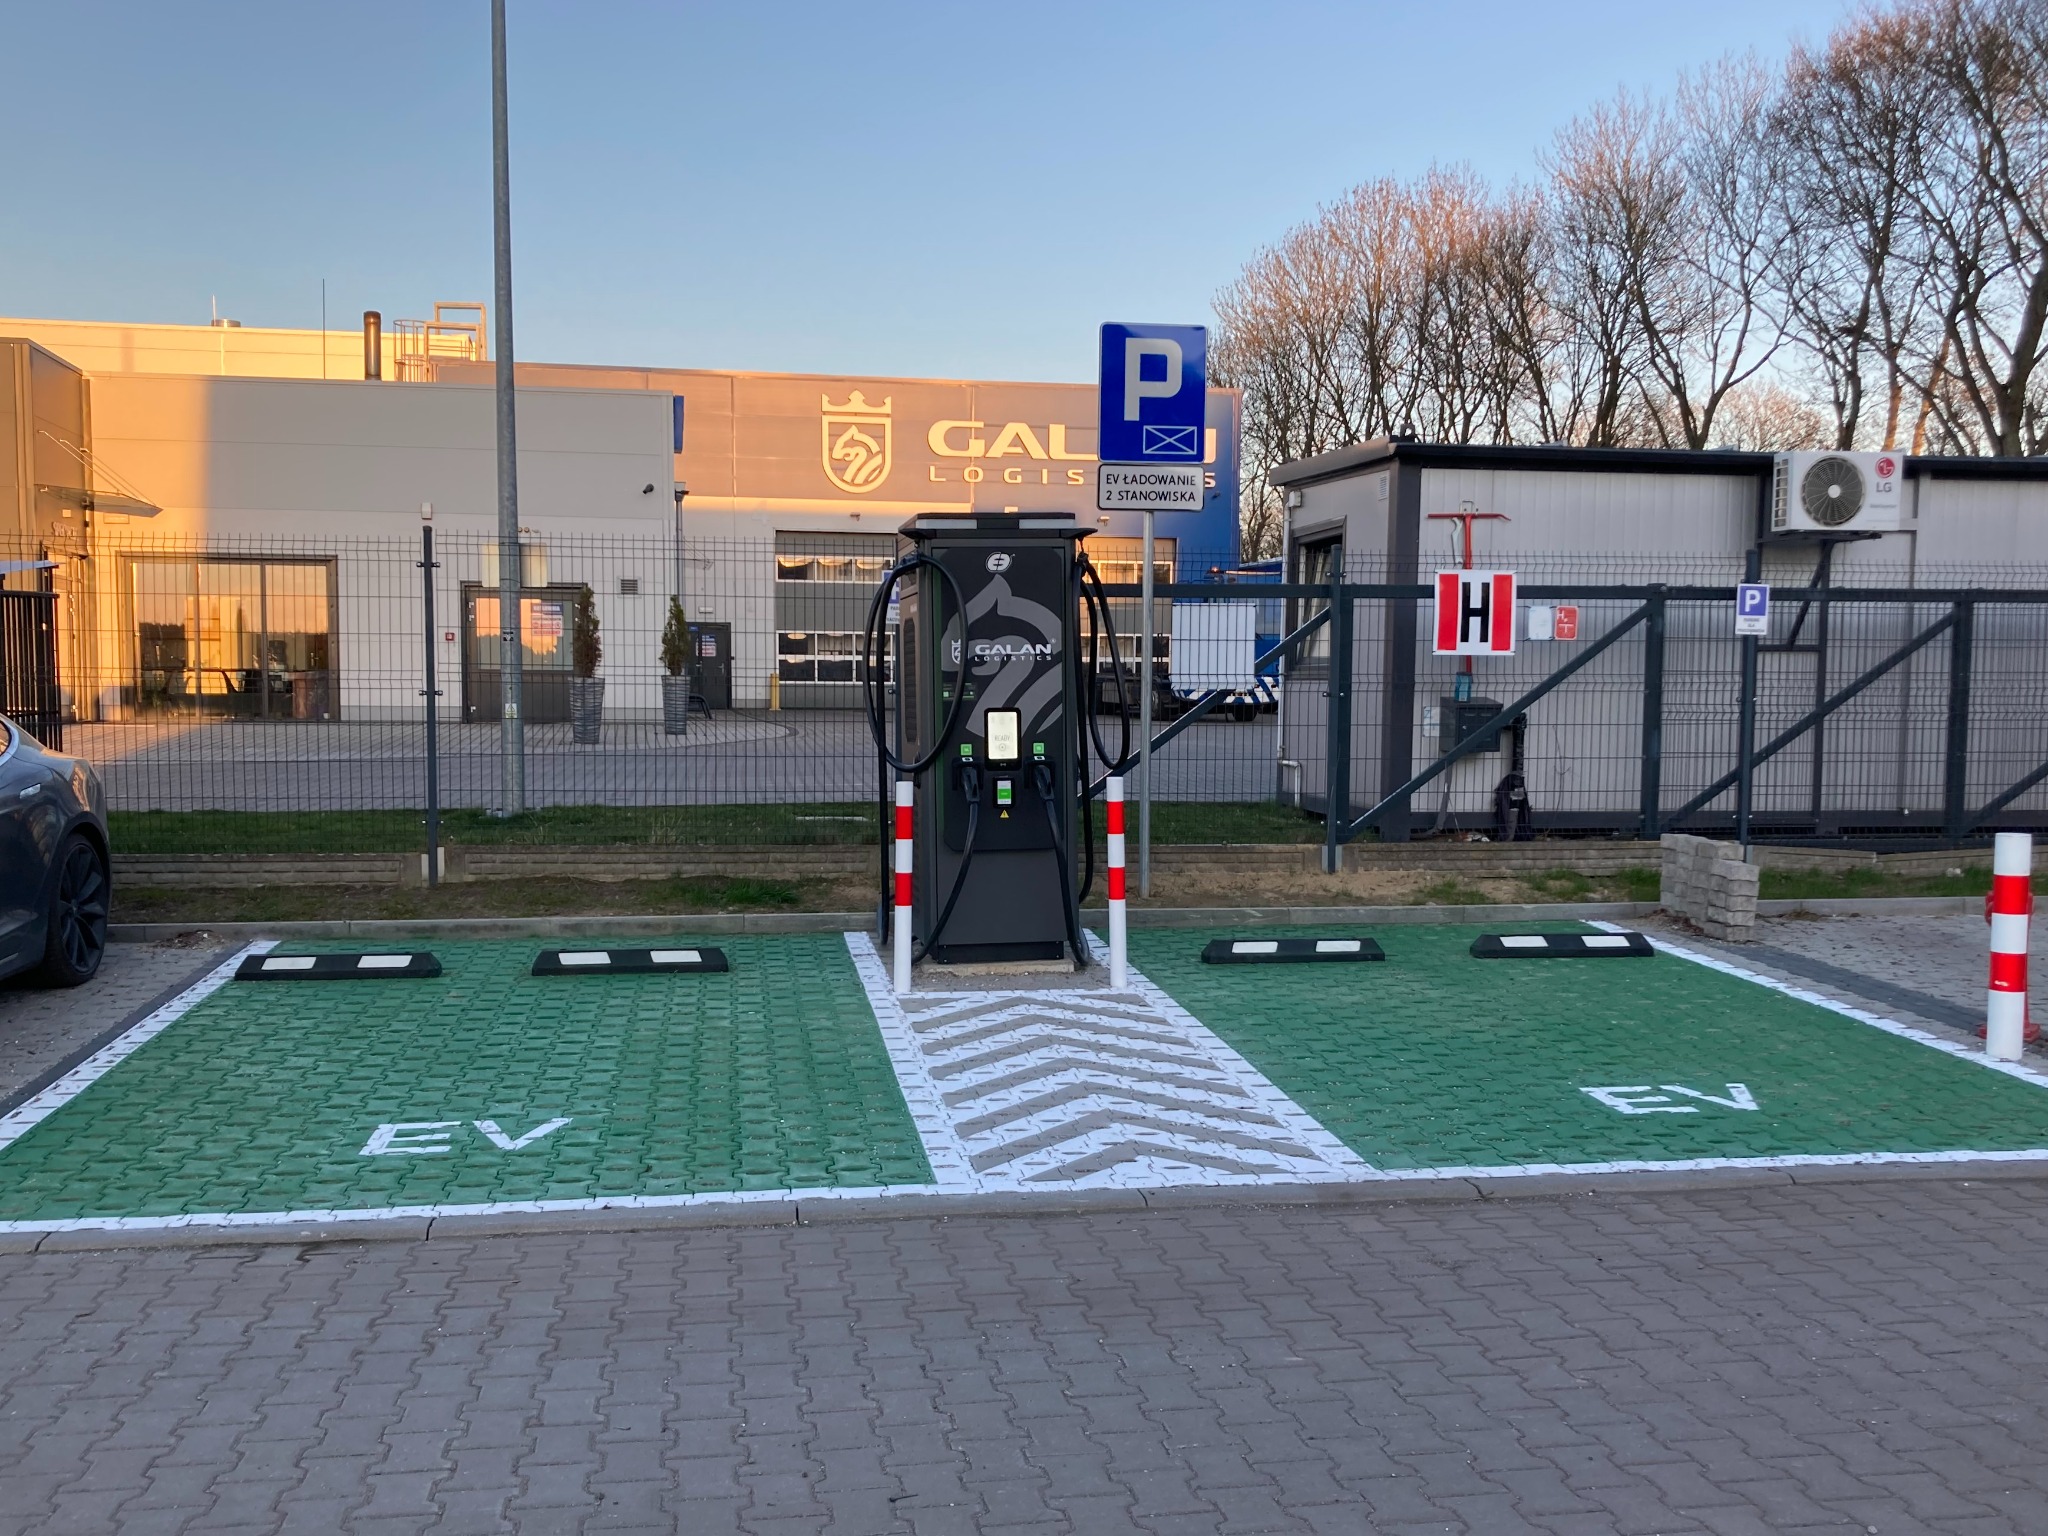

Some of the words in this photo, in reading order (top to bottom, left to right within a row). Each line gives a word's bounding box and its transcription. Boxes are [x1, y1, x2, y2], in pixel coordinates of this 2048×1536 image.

[1124, 337, 1182, 421] P
[927, 419, 1216, 464] GAL
[1106, 473, 1119, 485] EV
[1122, 474, 1196, 486] ŁADOWANIE
[1876, 481, 1892, 493] LG
[1106, 490, 1112, 501] 2
[1117, 490, 1196, 502] STANOWISKA
[1460, 581, 1490, 642] H
[1744, 589, 1761, 612] P
[974, 643, 1052, 655] GALAN
[1579, 1083, 1761, 1114] EV
[358, 1117, 574, 1156] EV
